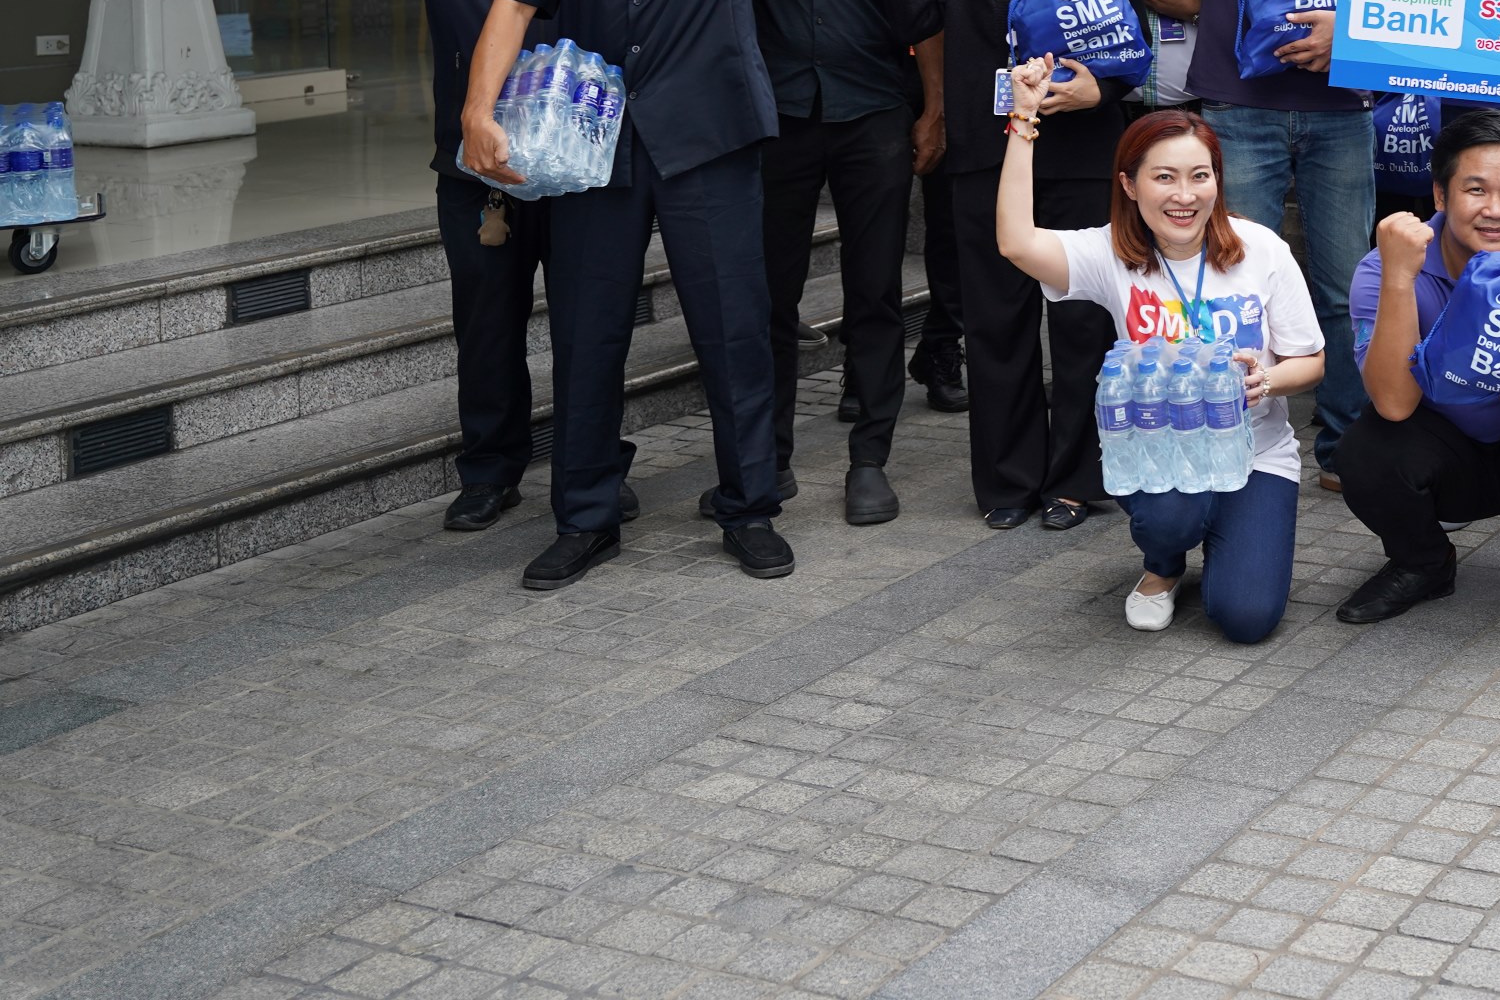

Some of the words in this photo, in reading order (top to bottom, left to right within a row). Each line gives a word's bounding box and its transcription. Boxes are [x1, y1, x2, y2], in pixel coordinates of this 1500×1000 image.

[1063, 12, 1124, 40] Development
[1362, 1, 1450, 36] Bank
[1066, 24, 1134, 53] Bank
[1374, 162, 1387, 171] พว.
[1212, 309, 1238, 338] D
